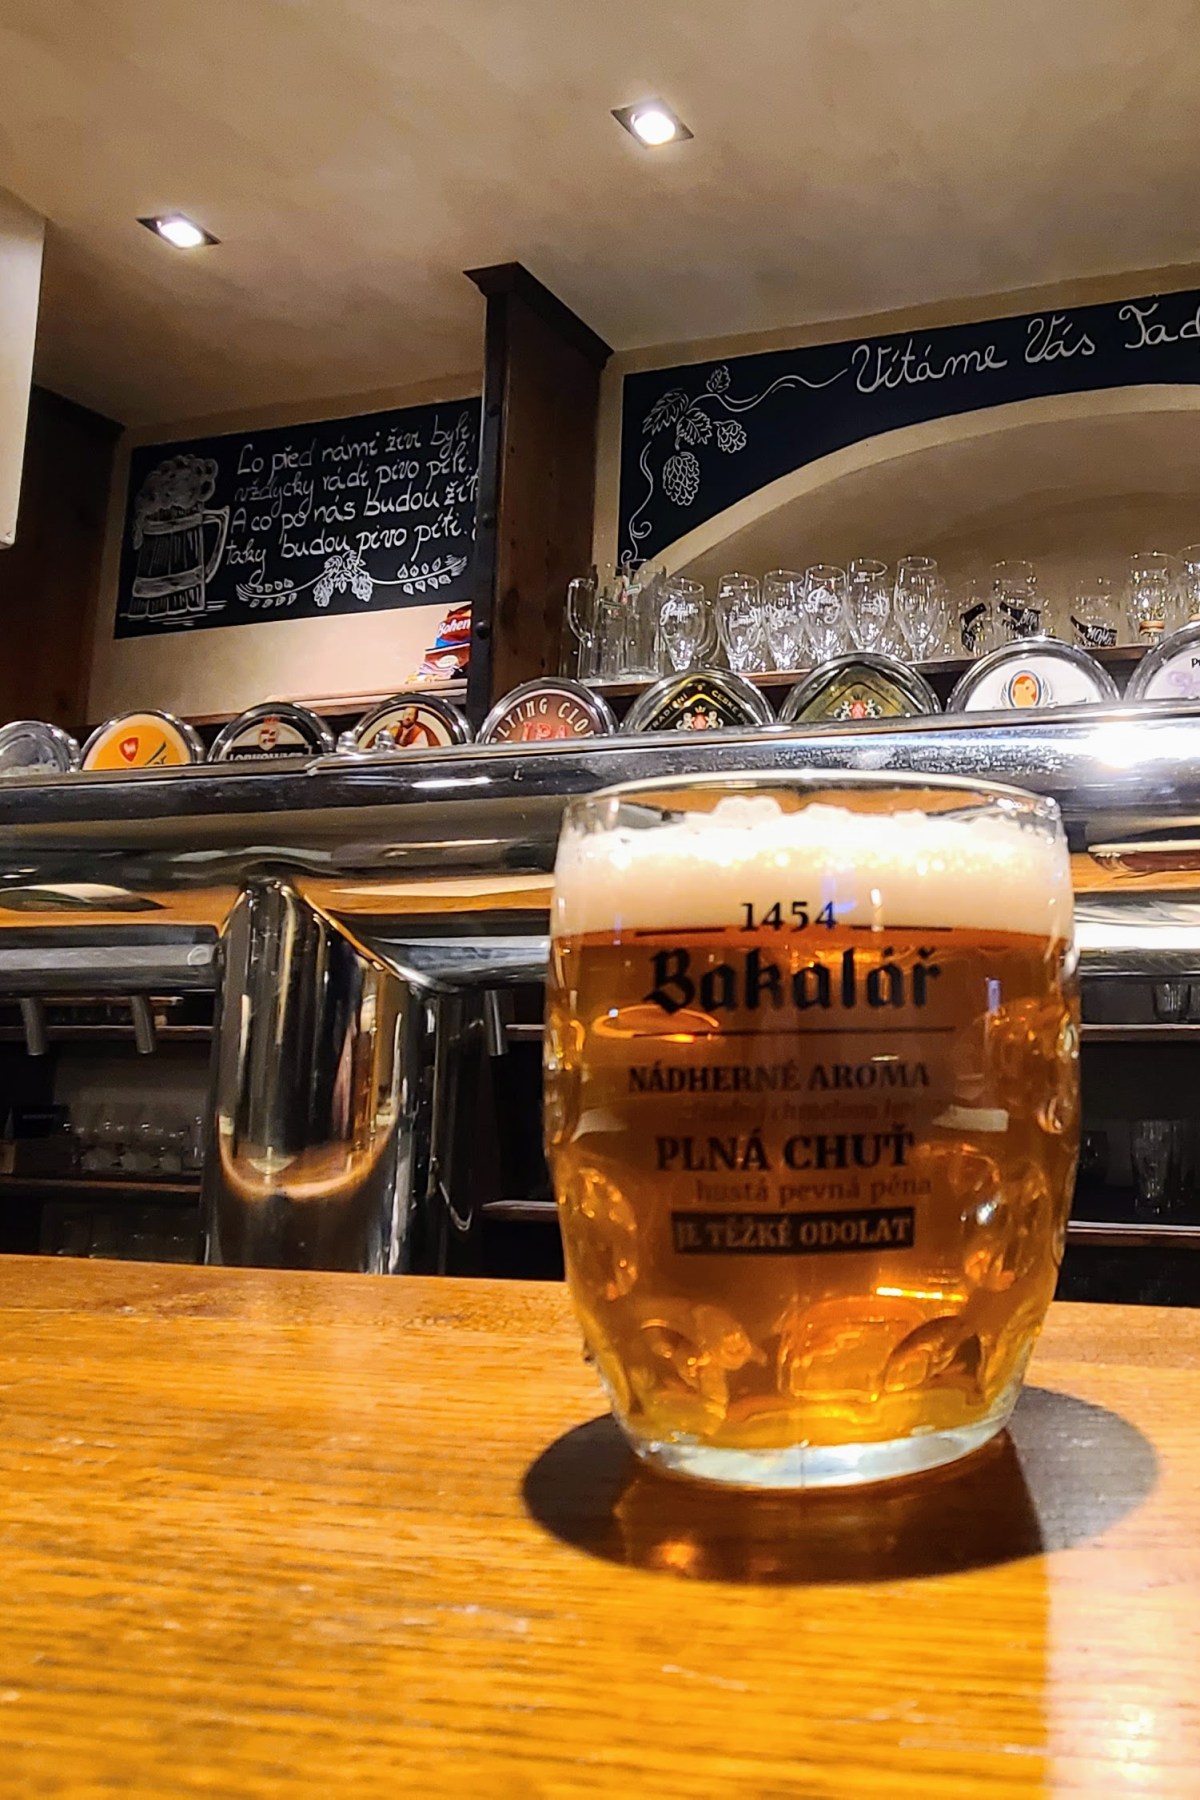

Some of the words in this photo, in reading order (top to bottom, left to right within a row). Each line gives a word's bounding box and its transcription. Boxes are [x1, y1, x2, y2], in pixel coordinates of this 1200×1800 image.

[852, 339, 1007, 393] Vítáme
[1025, 316, 1096, 362] Vás
[322, 434, 380, 462] námi
[231, 507, 246, 534] A
[251, 516, 272, 531] co
[279, 513, 306, 544] po
[314, 495, 355, 523] nás
[363, 481, 439, 516] budou
[444, 469, 479, 506] žít
[235, 471, 314, 518] vždycky
[323, 460, 369, 490] rádi
[375, 459, 419, 502] pivo
[225, 538, 266, 587] taky
[281, 528, 350, 558] budou
[356, 525, 407, 564] pivo
[522, 722, 568, 741] IPA
[558, 702, 594, 738] CLO
[741, 901, 837, 932] 1454
[642, 947, 943, 1014] Bakalář
[628, 1061, 799, 1093] NÁDHERNÉ
[810, 1061, 930, 1092] AROMA
[655, 1127, 771, 1172] PLNÁ
[784, 1123, 914, 1171] CHUŤ
[799, 1217, 911, 1246] ODOLAT
